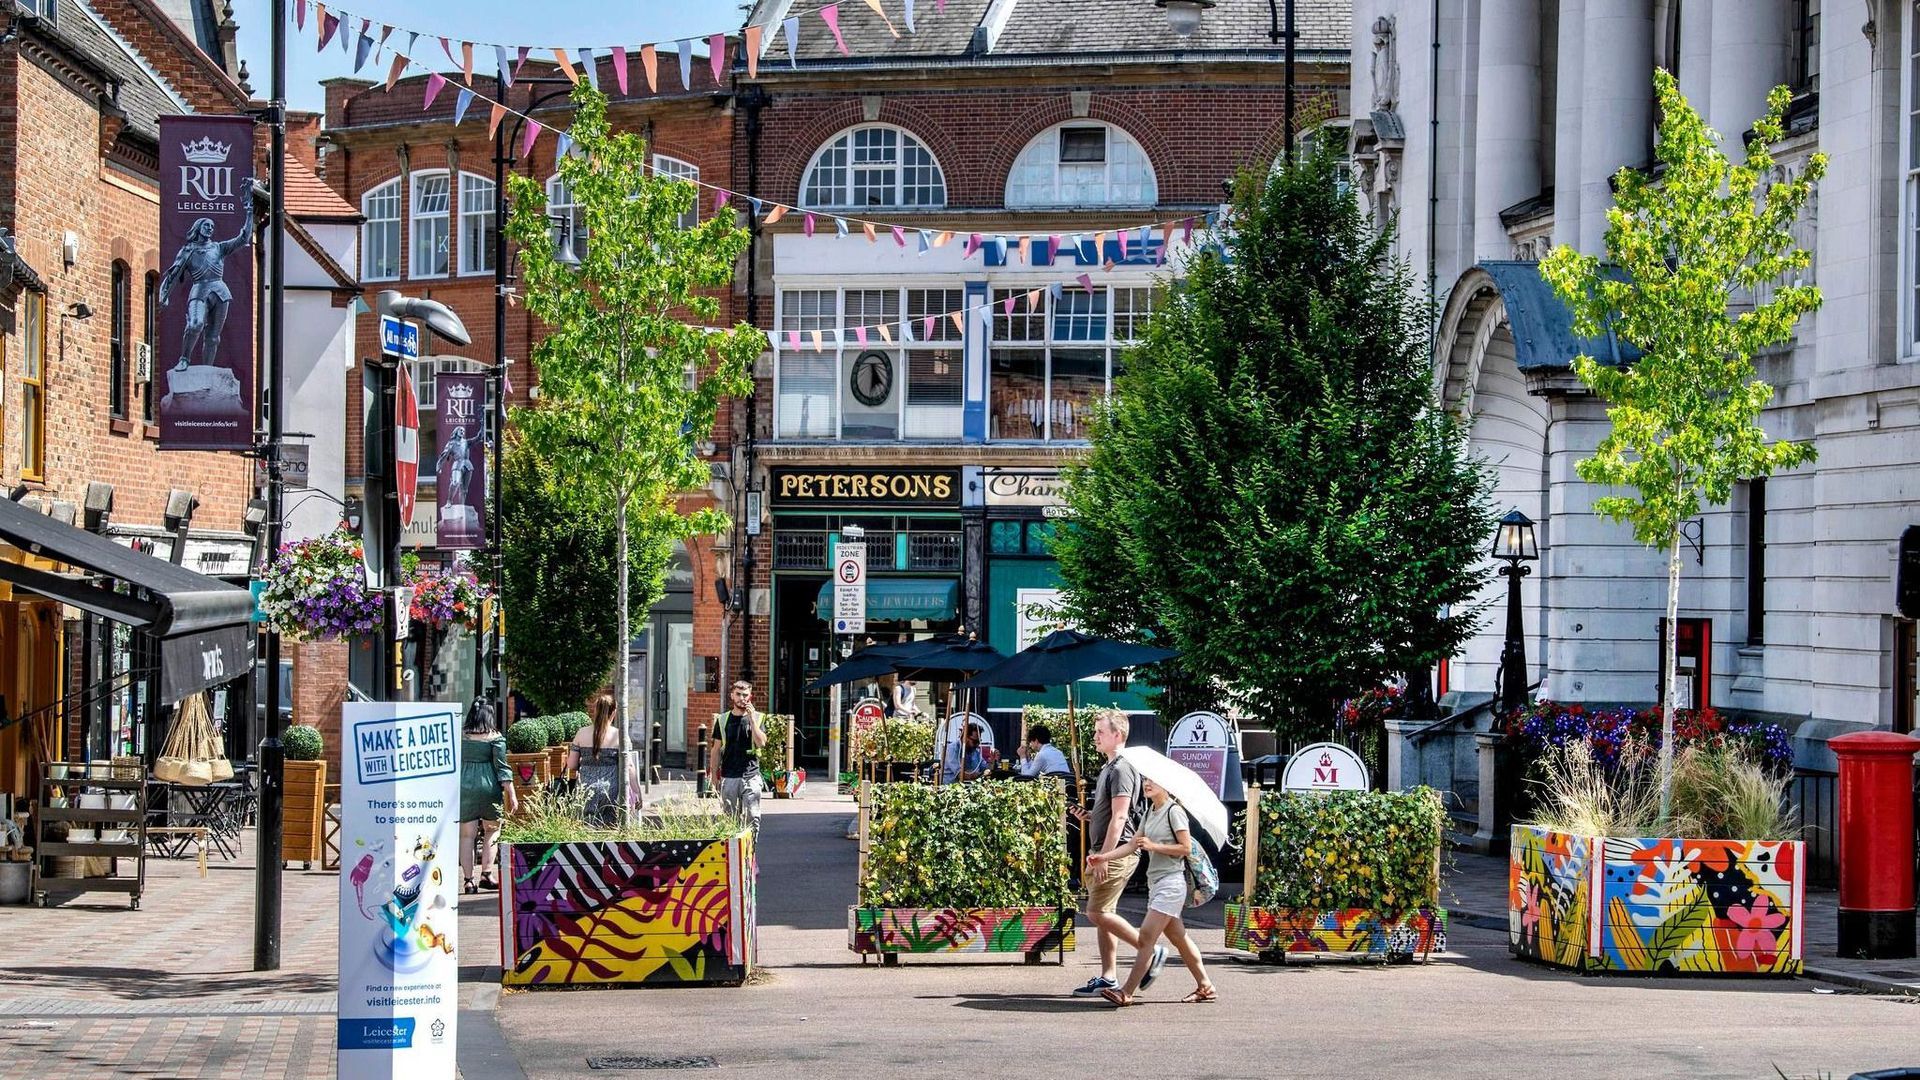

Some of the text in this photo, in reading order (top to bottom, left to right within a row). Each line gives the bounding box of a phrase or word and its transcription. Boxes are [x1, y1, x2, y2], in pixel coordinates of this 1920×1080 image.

[177, 201, 235, 211] LEICESTER
[780, 474, 951, 498] PETERSONS
[362, 722, 448, 752] MAKE A DATE
[1190, 730, 1208, 742] M
[365, 747, 451, 773] WITH LEICESTER
[1182, 752, 1212, 761] SUNDAY
[1192, 761, 1210, 769] MENU
[1313, 767, 1339, 784] M
[367, 800, 444, 809] There's so much
[375, 815, 438, 824] to see and do
[366, 995, 441, 1007] visitleicester.info
[363, 1024, 408, 1037] Leicester
